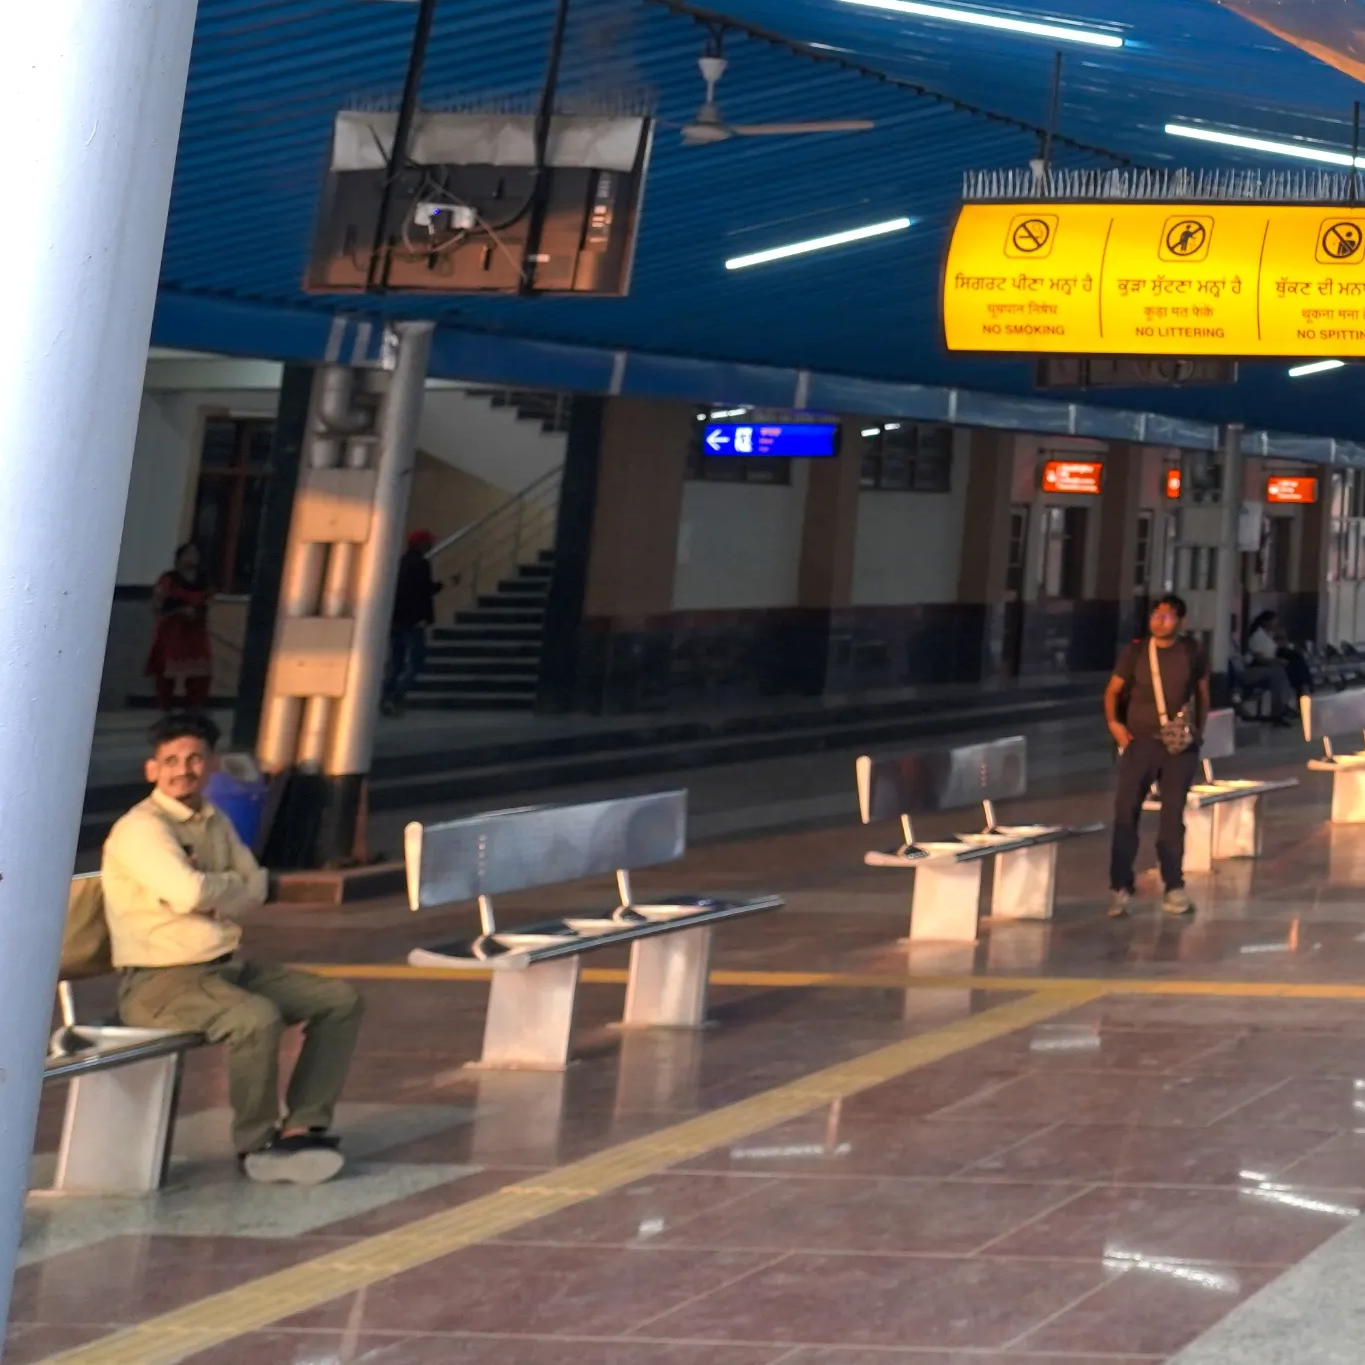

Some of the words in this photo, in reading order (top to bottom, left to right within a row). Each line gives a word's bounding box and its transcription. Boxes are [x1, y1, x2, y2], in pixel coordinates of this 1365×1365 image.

[982, 323, 1002, 335] NO
[1004, 323, 1066, 336] SMOKING
[1135, 326, 1155, 338] NO
[1158, 326, 1225, 339] LITTERING
[1297, 328, 1317, 340] NO
